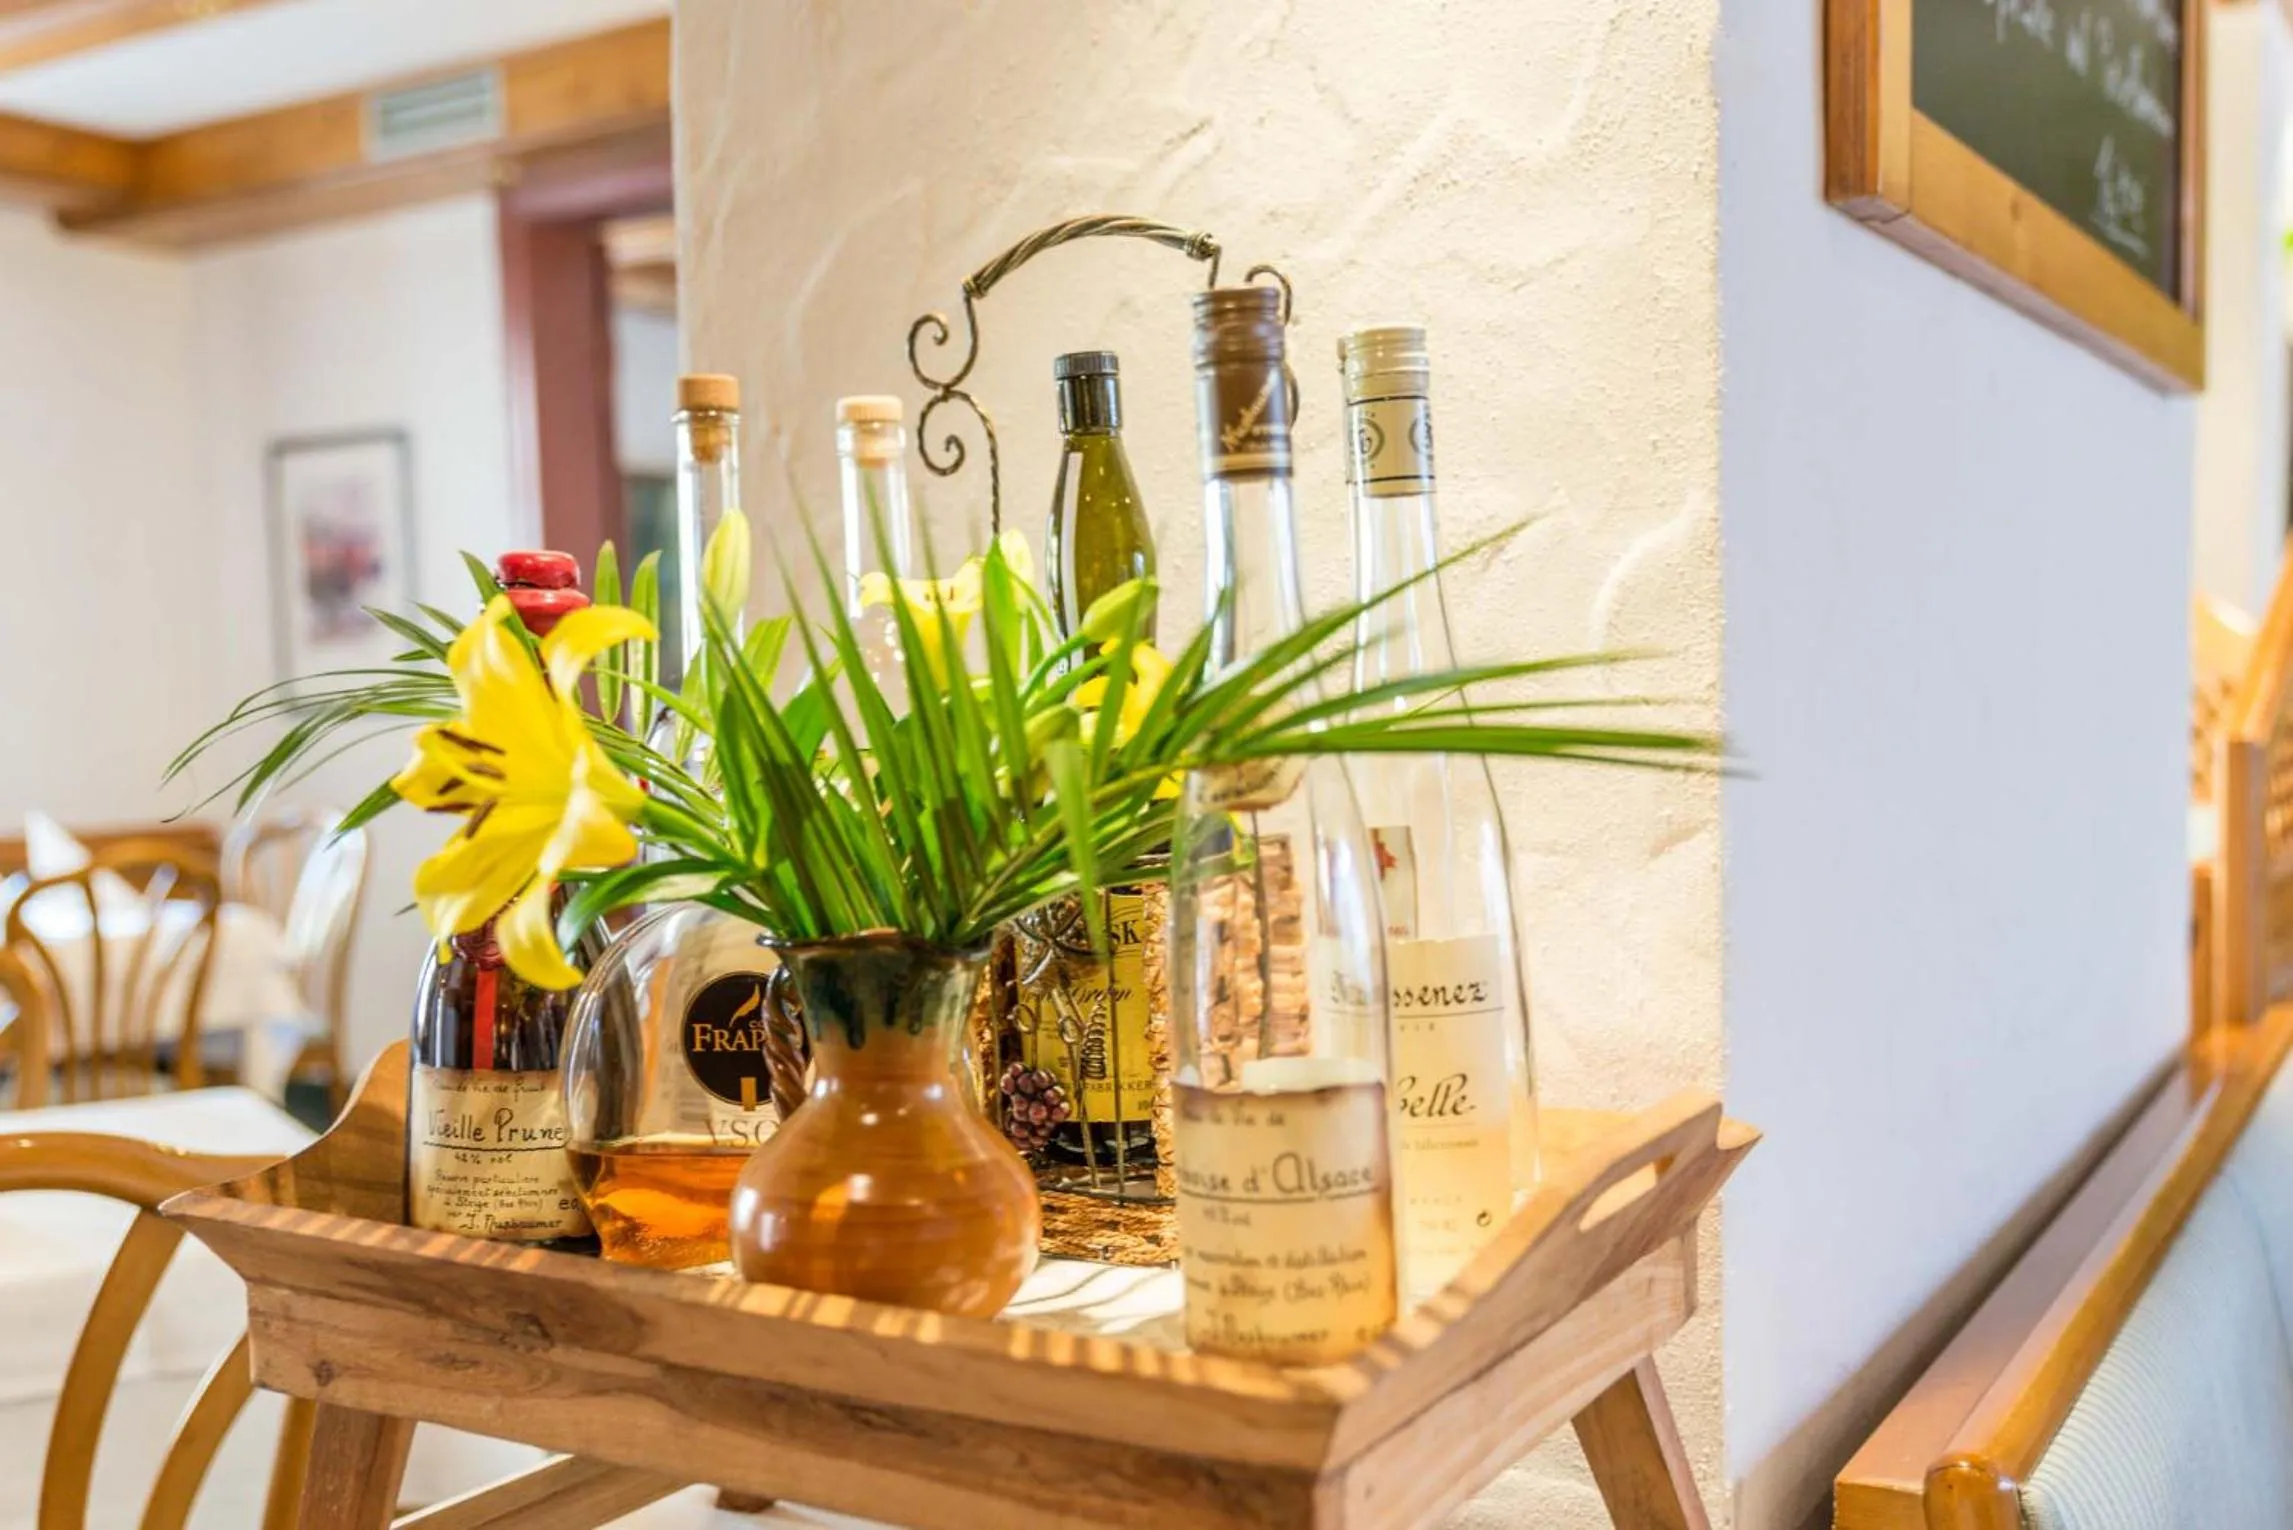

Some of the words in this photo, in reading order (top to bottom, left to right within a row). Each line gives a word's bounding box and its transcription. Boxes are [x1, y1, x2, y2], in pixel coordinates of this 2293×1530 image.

[1109, 919, 1142, 945] SK
[692, 1023, 766, 1053] FRAP
[494, 1107, 564, 1143] Prune
